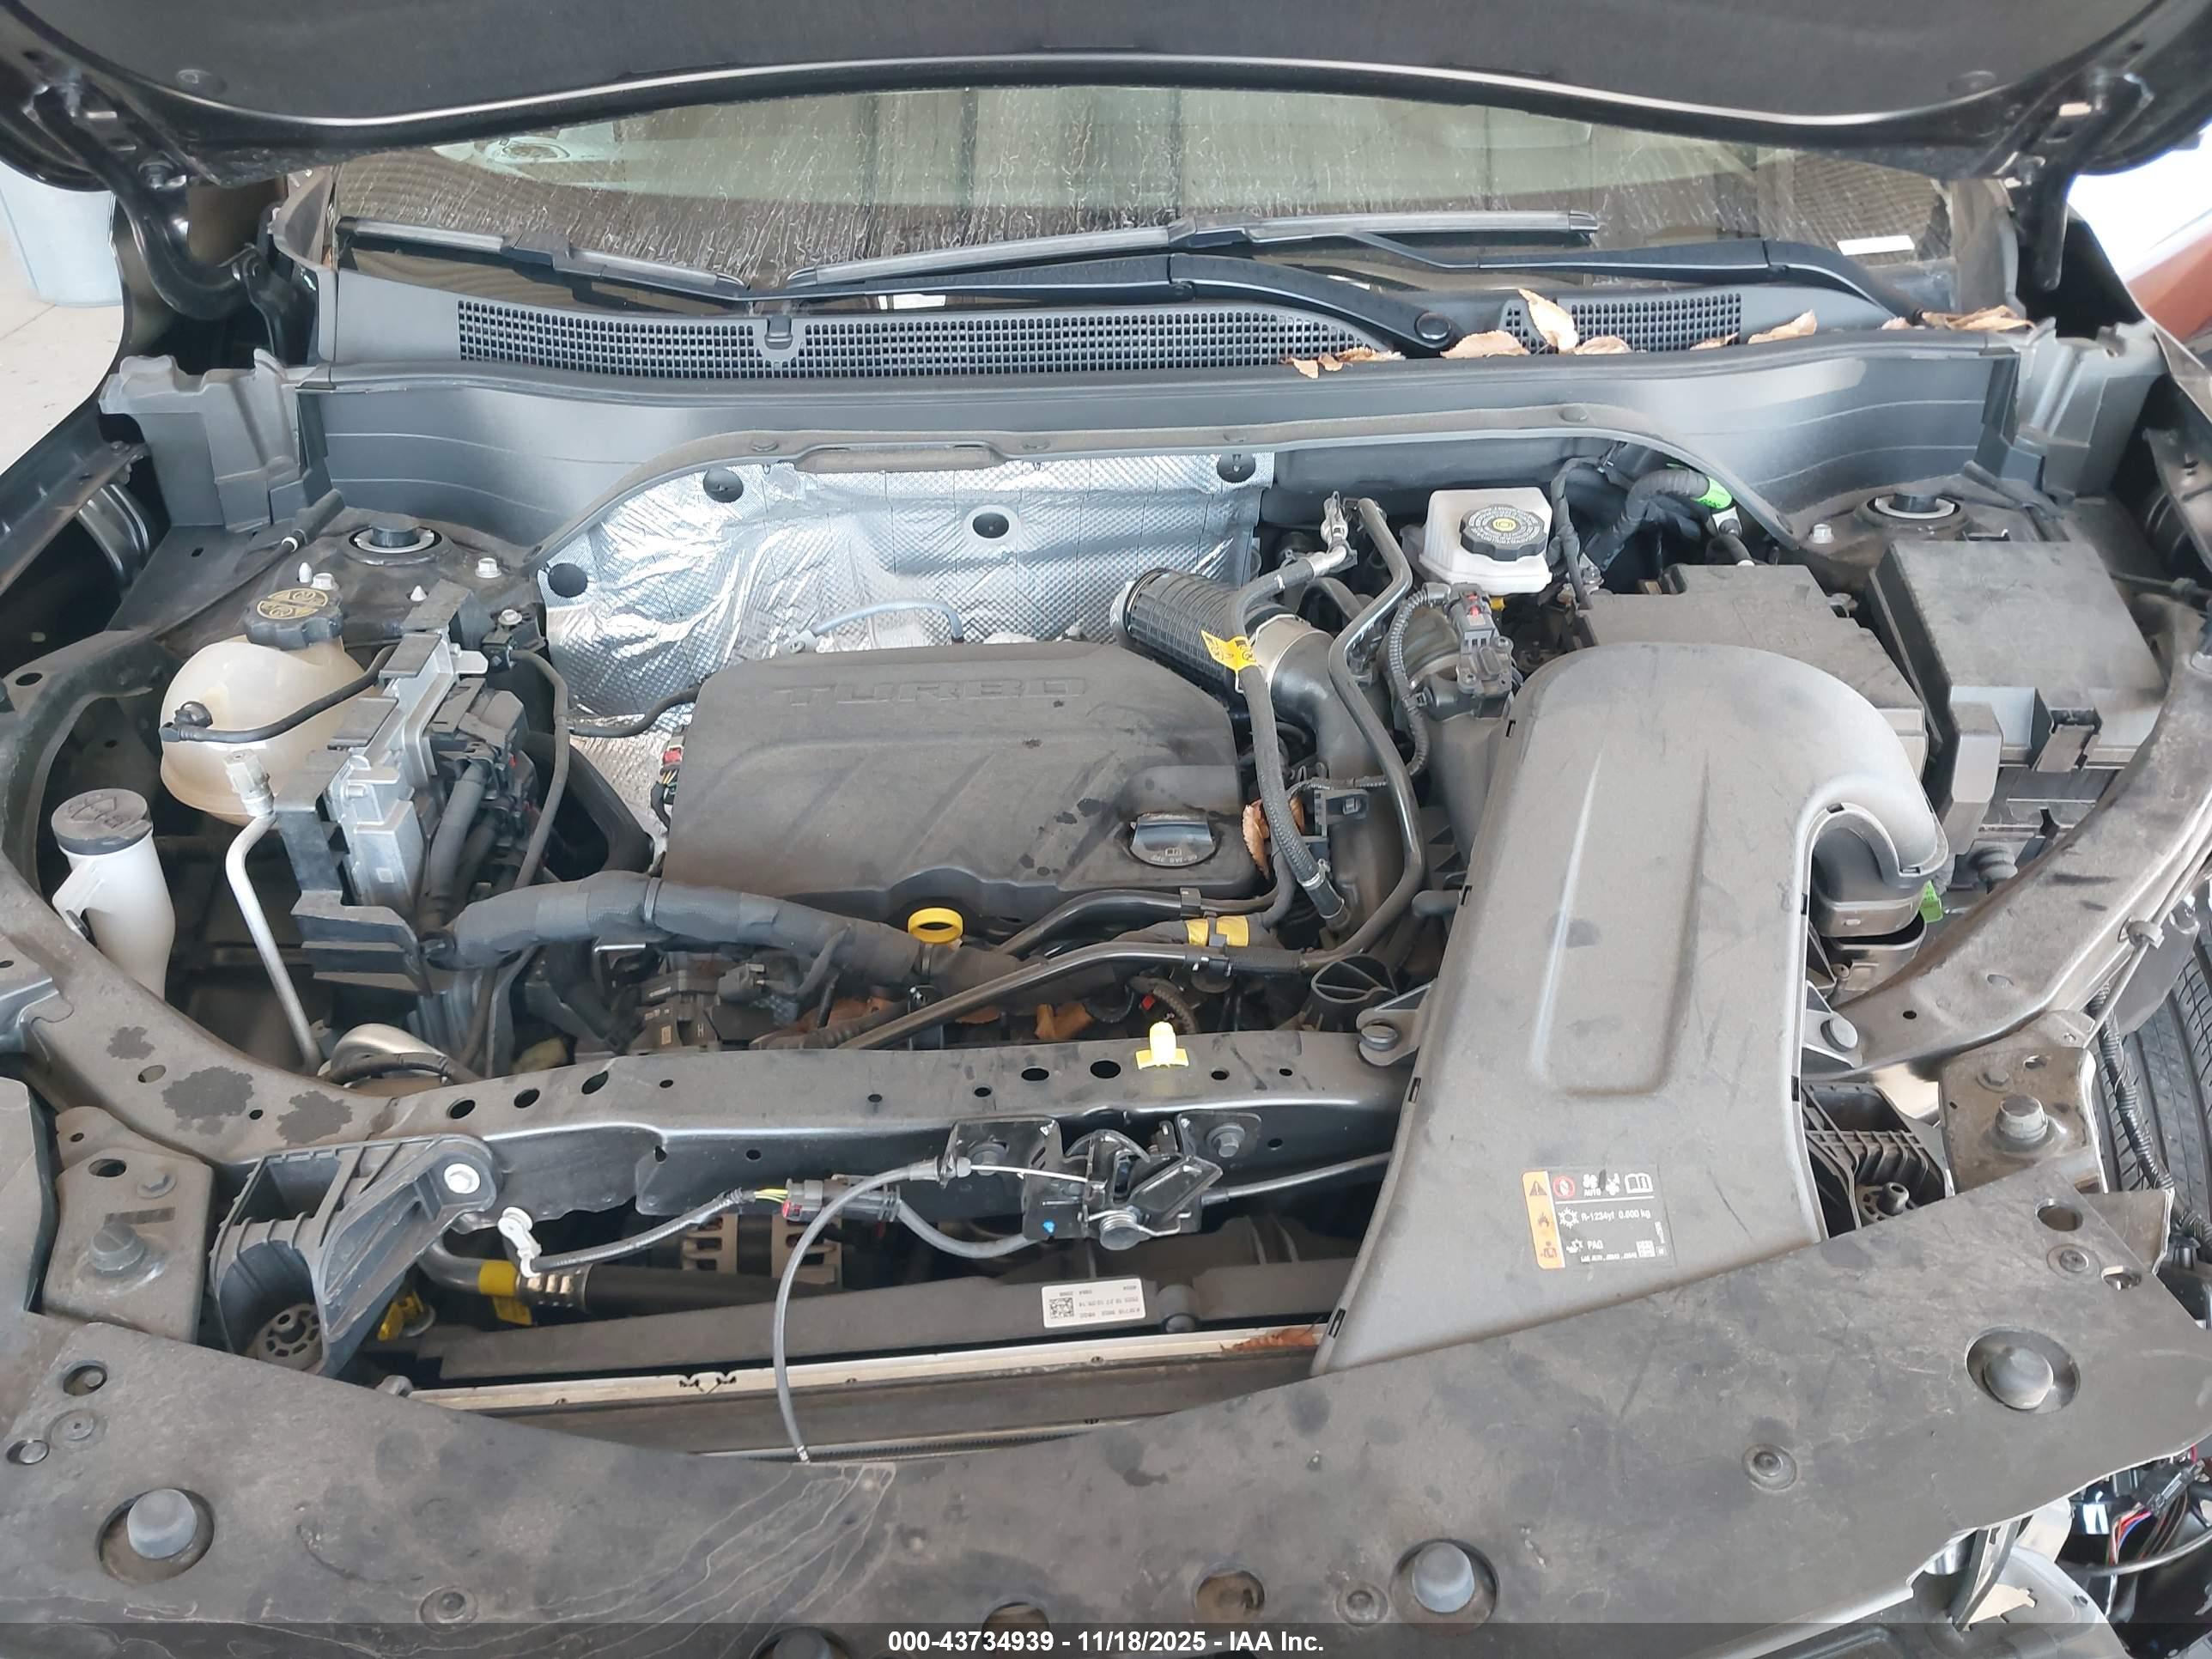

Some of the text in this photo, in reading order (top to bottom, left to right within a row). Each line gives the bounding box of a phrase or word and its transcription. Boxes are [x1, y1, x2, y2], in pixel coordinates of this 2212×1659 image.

[773, 677, 1087, 706] TURBO
[1583, 1188, 1601, 1197] AUTO
[1640, 1208, 1651, 1219] kg
